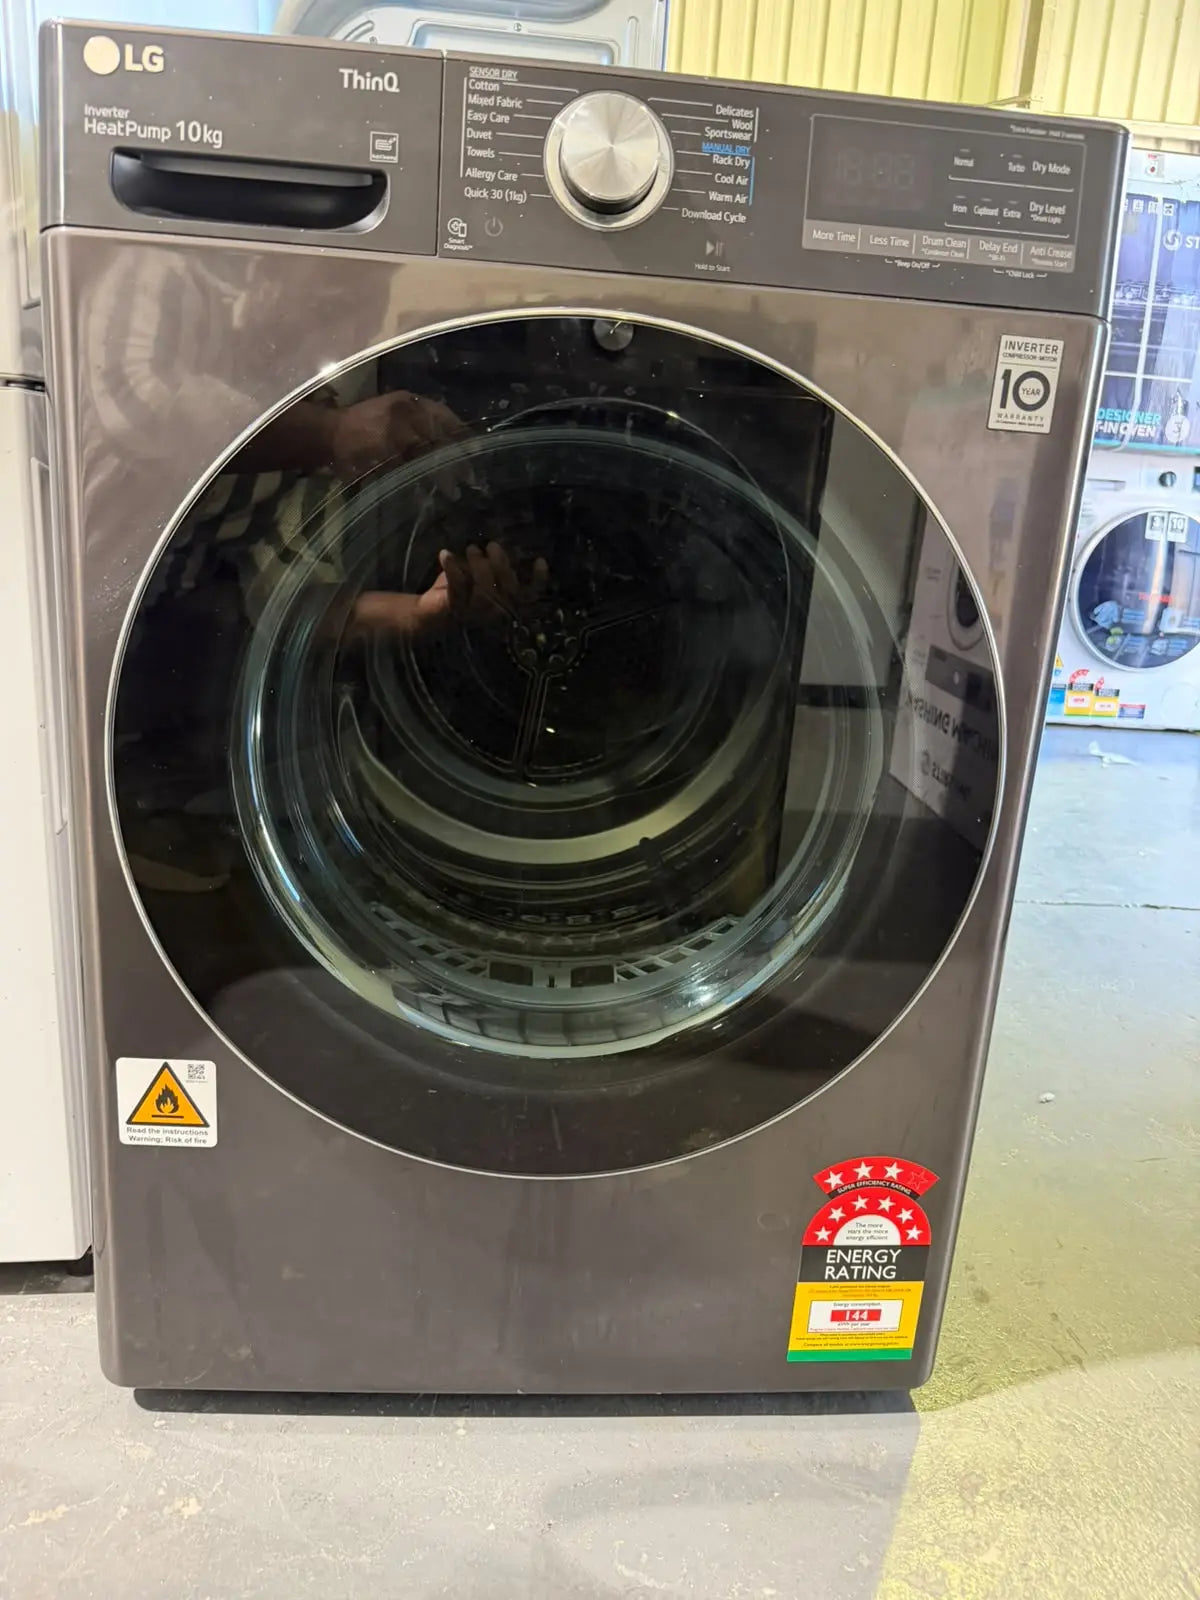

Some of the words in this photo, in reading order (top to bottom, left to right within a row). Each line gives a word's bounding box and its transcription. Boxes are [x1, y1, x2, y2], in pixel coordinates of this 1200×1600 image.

[124, 45, 164, 72] LG
[339, 68, 400, 92] ThinQ
[469, 66, 499, 78] SENSOR
[501, 70, 518, 80] DRY
[469, 80, 500, 92] Cotton
[468, 94, 495, 106] Mixed
[497, 96, 522, 108] Fabric
[84, 104, 129, 119] Inverter
[467, 110, 488, 124] Easy
[490, 112, 510, 124] Care
[716, 104, 754, 118] Delicates
[732, 119, 753, 130] Wool
[466, 128, 492, 140] Duvet
[704, 126, 752, 141] Sportswear
[466, 147, 495, 158] Towels
[702, 142, 731, 154] MANUAL
[732, 144, 750, 154] DRY
[713, 154, 732, 166] Rack
[733, 156, 750, 169] Dry
[1032, 160, 1047, 175] Dry
[1048, 163, 1070, 175] Mode
[466, 168, 496, 182] Allergy
[498, 170, 518, 182] Care
[714, 173, 734, 184] Cool
[734, 175, 749, 186] Air
[464, 188, 489, 200] Quick
[490, 190, 502, 200] 30
[504, 190, 526, 204] (1kg)
[708, 190, 734, 202] Warm
[734, 192, 747, 204] Air
[682, 208, 721, 222] Download
[723, 210, 746, 224] Cycle
[952, 204, 968, 214] Iron
[1003, 208, 1022, 219] Extra
[1030, 202, 1044, 216] Dry
[1046, 204, 1066, 216] Level
[812, 229, 833, 240] More
[835, 231, 856, 244] Time
[870, 234, 888, 246] Less
[889, 236, 910, 248] Time
[922, 235, 943, 247] Drum
[944, 237, 966, 250] Clean
[979, 240, 1001, 254] Delay
[1002, 242, 1018, 254] End
[1030, 245, 1044, 258] Anti
[1046, 247, 1073, 259] Crease
[1004, 340, 1058, 354] INVERTER
[1000, 368, 1050, 412] 10
[1022, 388, 1040, 396] YEAR
[996, 412, 1044, 422] WARRANTY
[162, 1128, 208, 1136] instructions
[837, 1184, 856, 1194] SUPER
[890, 1182, 912, 1195] RATING
[826, 1249, 902, 1264] ENERGY
[824, 1266, 897, 1280] RATING
[845, 1310, 868, 1320] 144
